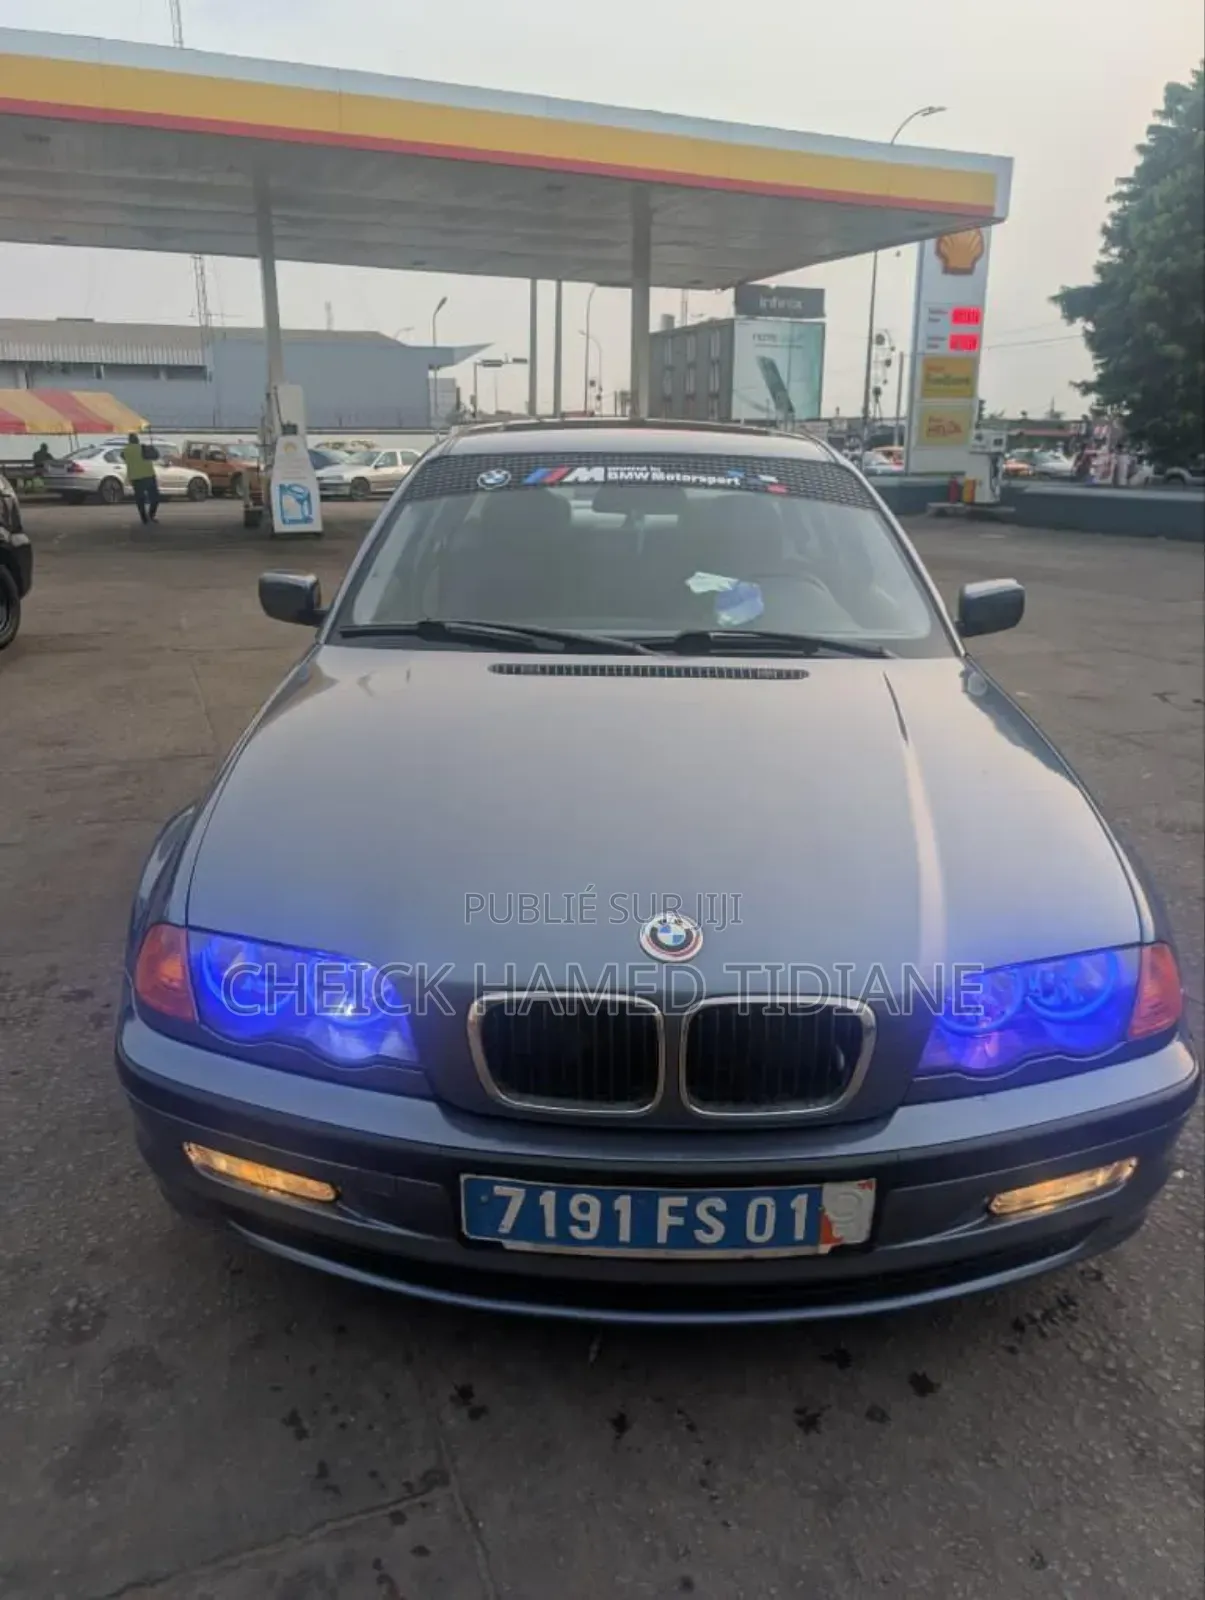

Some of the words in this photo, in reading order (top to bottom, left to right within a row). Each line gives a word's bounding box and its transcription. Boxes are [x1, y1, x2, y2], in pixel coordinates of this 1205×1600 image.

[607, 471, 650, 481] BMW
[651, 472, 741, 486] Motorsport
[493, 1184, 632, 1243] 7191
[657, 1196, 728, 1245] FS
[745, 1193, 809, 1244] 01
